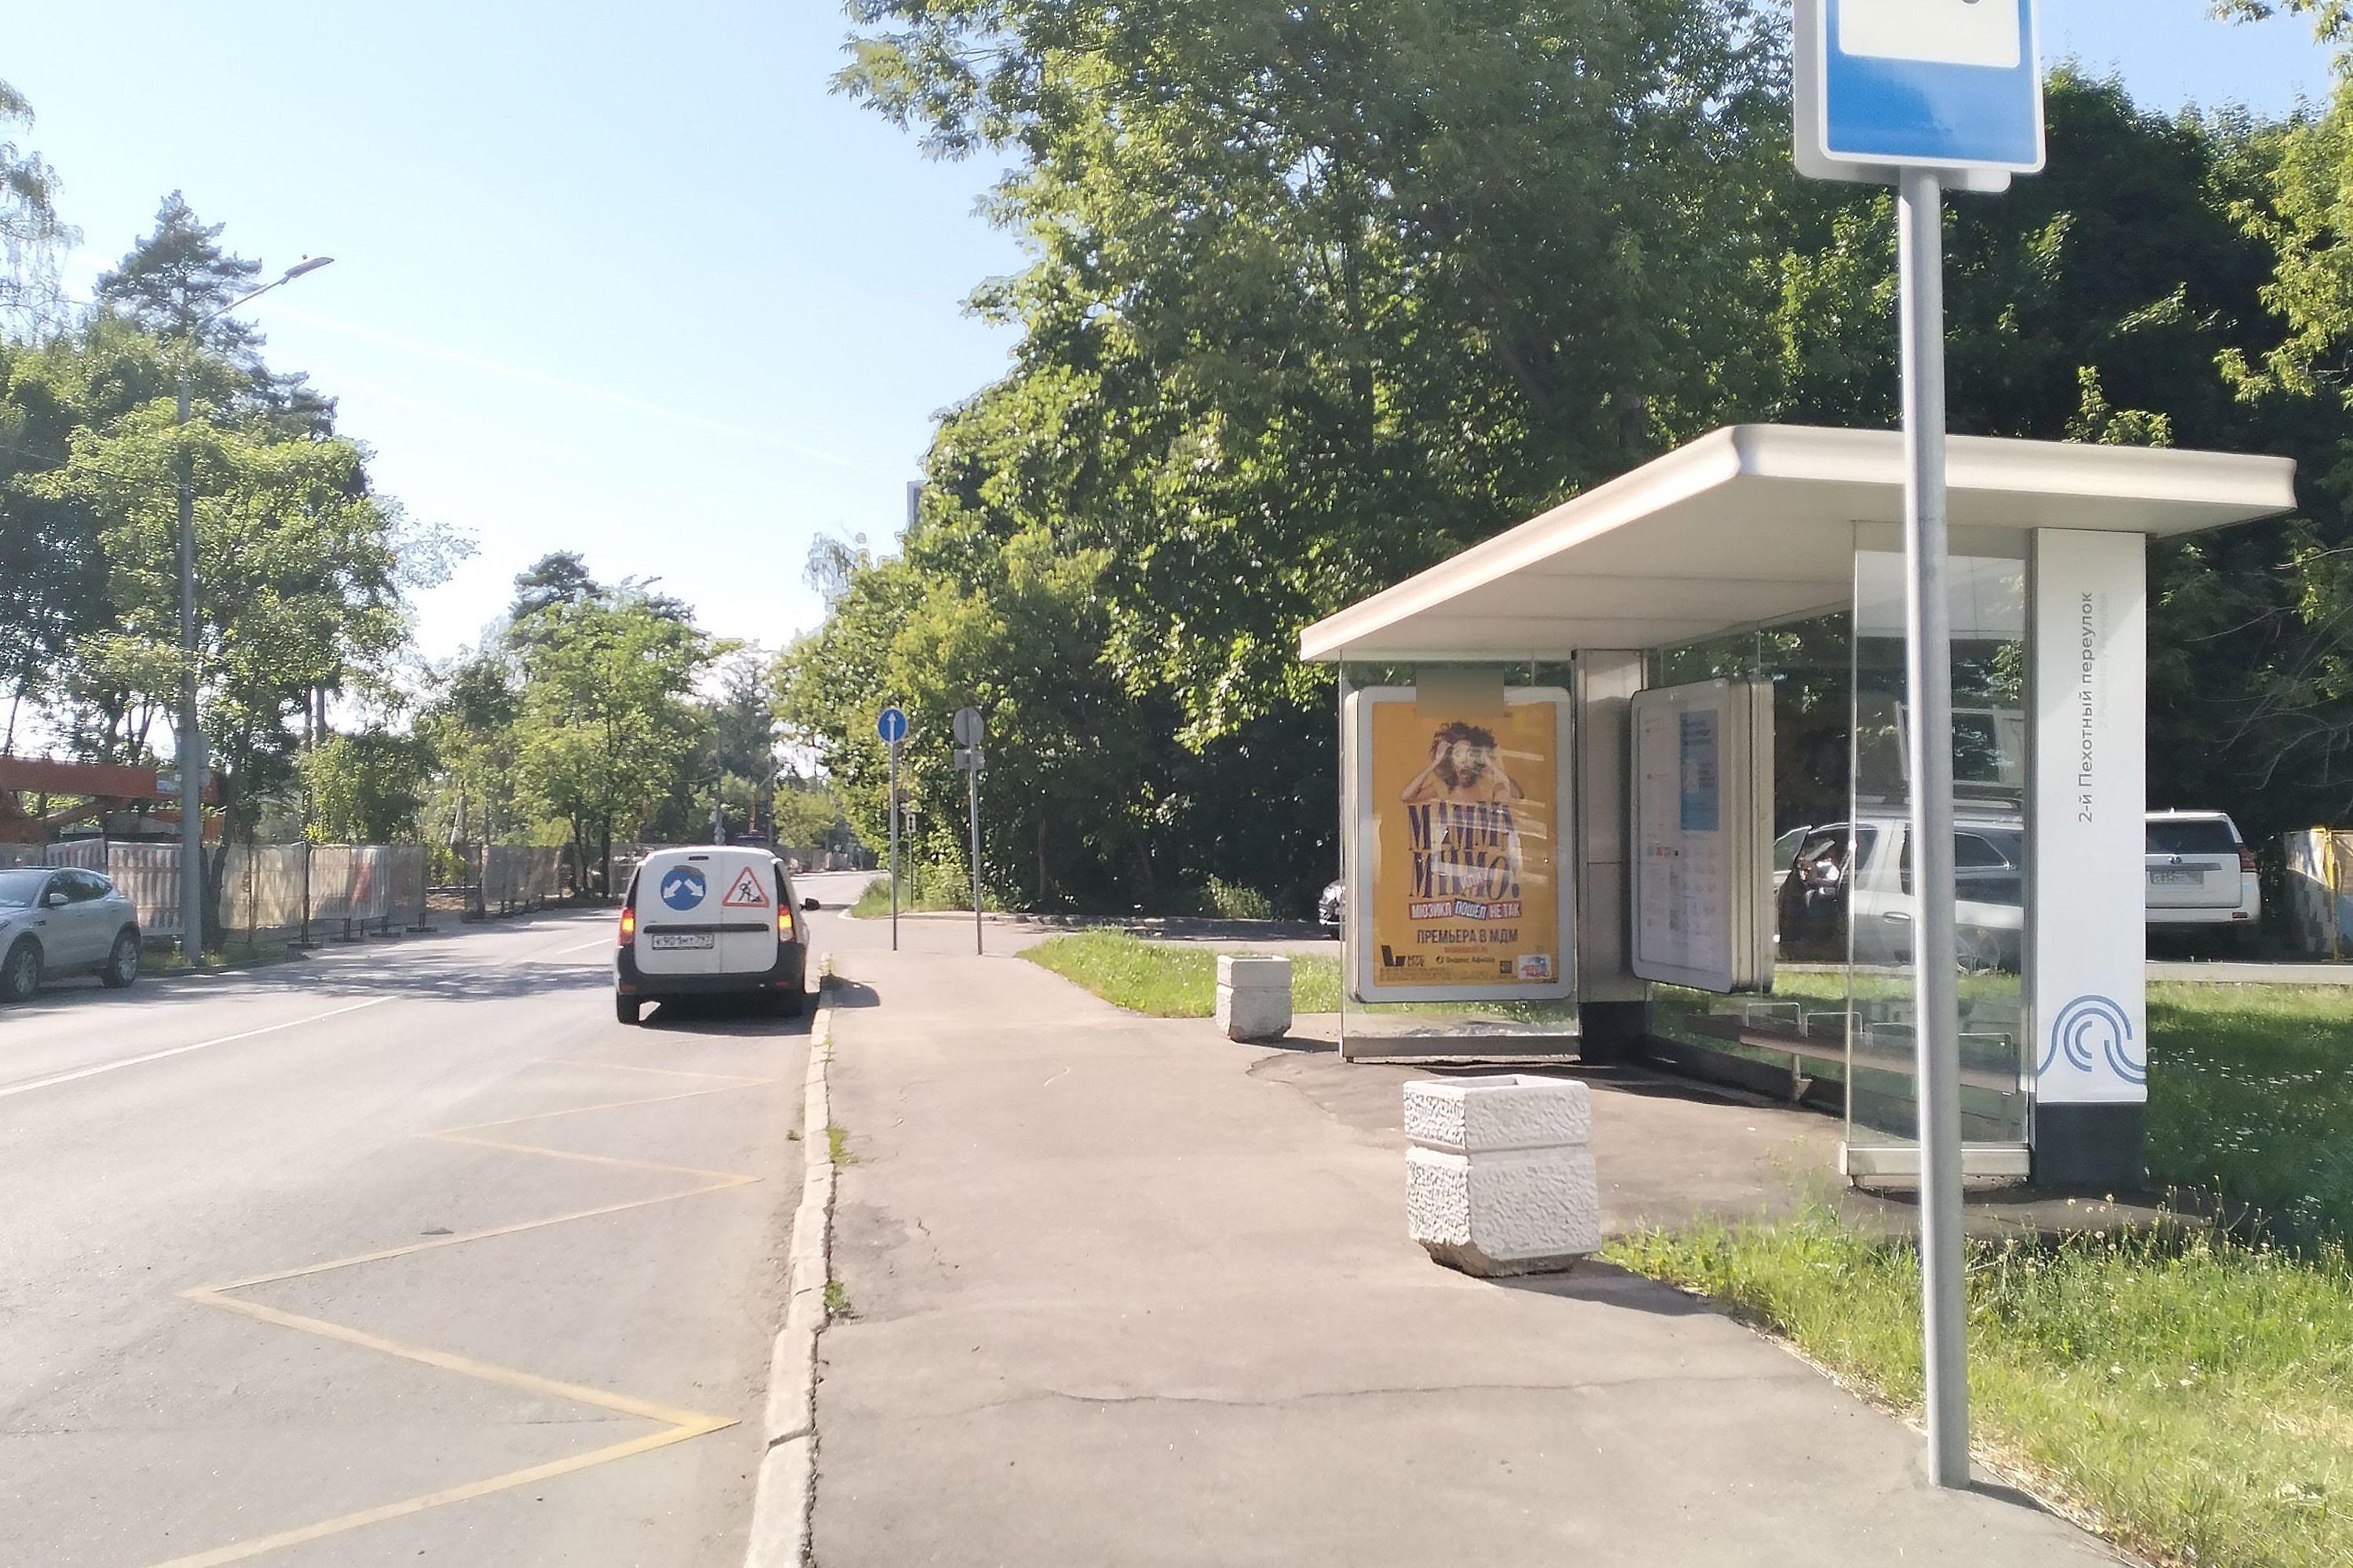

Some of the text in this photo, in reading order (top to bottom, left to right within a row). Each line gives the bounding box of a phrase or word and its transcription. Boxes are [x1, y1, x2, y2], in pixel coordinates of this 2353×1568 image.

[2079, 591, 2096, 823] 2-й Пехотный переулок
[1411, 901, 1452, 918] МЮЗИКЛ
[1489, 903, 1502, 918] НЕ
[1502, 902, 1520, 917] ТАК
[1417, 929, 1519, 944] ПРЕМЬЕРА В МДМ
